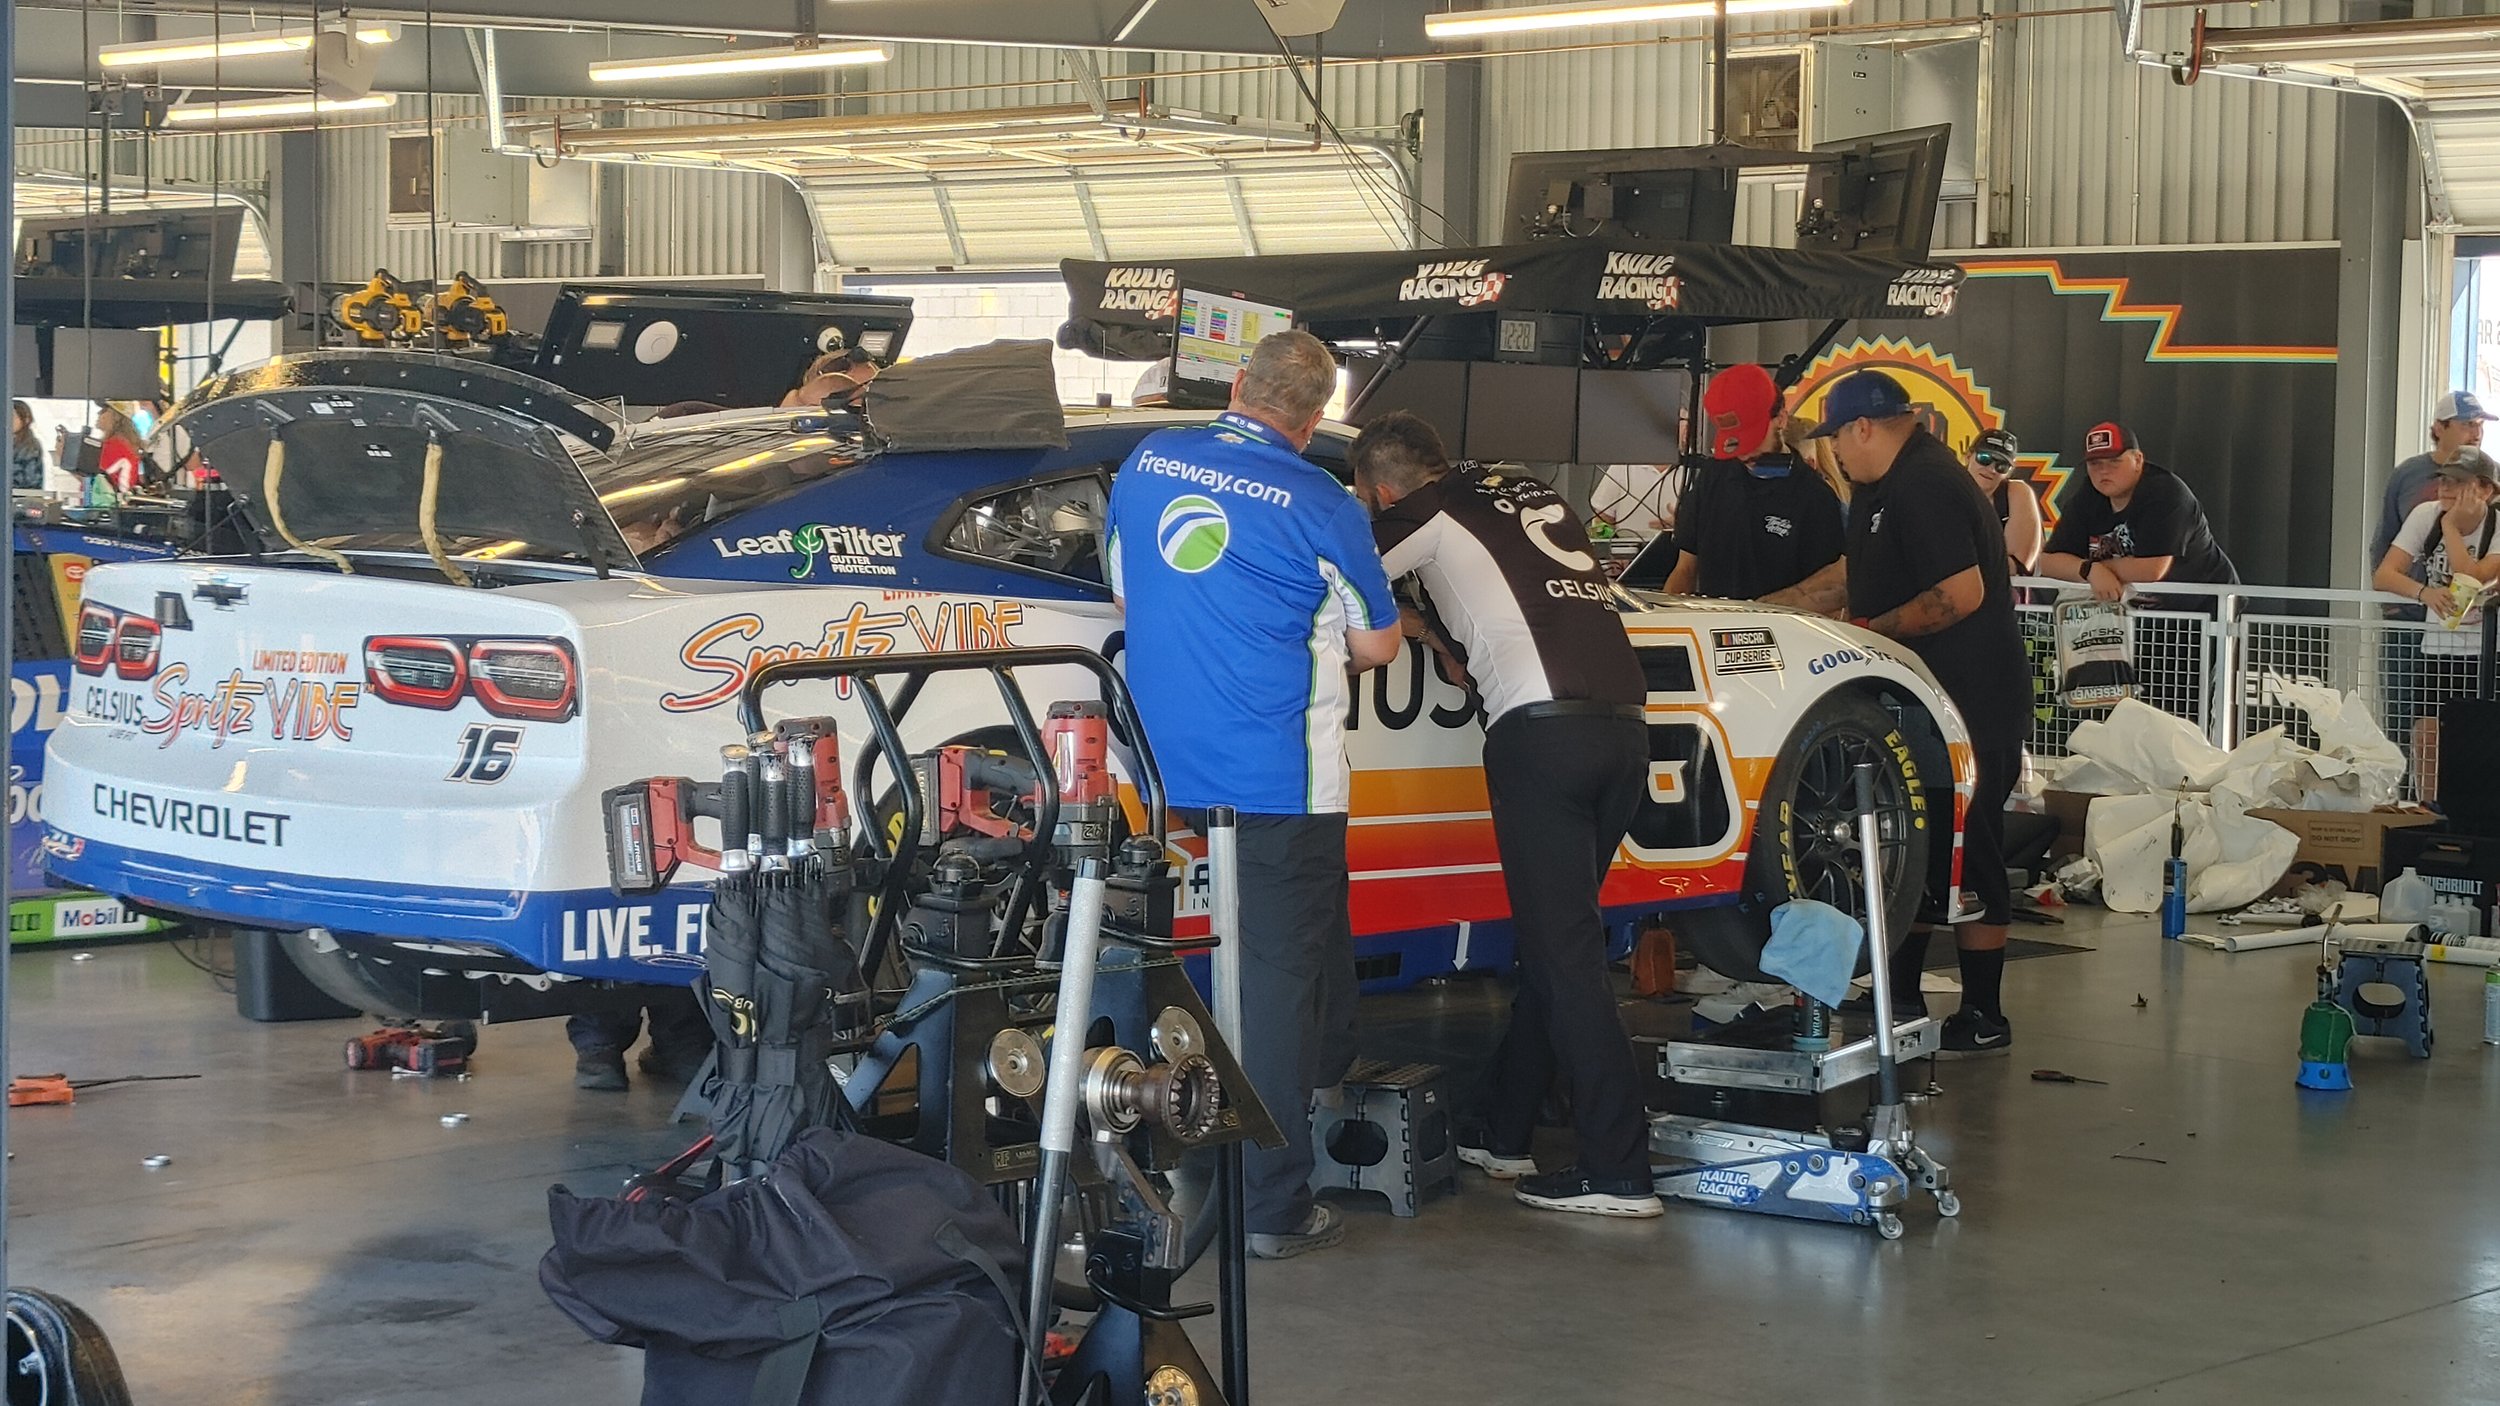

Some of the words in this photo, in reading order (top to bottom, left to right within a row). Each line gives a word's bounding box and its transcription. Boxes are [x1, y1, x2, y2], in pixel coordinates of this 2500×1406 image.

[1604, 251, 1675, 275] KAULIG
[1104, 267, 1175, 289] KAULIG
[1399, 275, 1484, 301] RACING
[1597, 276, 1664, 299] RACING
[1099, 288, 1170, 310] RACING
[1886, 284, 1943, 307] RACING
[1503, 321, 1534, 350] 12:28
[1136, 449, 1293, 508] Freeway.com
[829, 555, 871, 565] GUTTER
[832, 564, 897, 575] PROTECTION
[906, 601, 1024, 652] VIBE
[1732, 631, 1766, 646] NASCAR
[253, 650, 296, 672] LIMITED
[299, 651, 349, 675] EDITION
[1724, 650, 1742, 664] CUP
[1743, 649, 1772, 663] SERIES
[86, 685, 143, 725] CELSIUS
[140, 660, 264, 750] Spritz
[265, 677, 362, 743] VIBE
[444, 721, 527, 786] 16
[1884, 728, 1926, 812] EAGLE
[94, 782, 291, 847] CHEVROLET
[62, 907, 118, 929] Mobil
[562, 905, 664, 962] LIVE.
[1697, 1181, 1748, 1198] RACING
[1701, 1170, 1750, 1186] KAULIG
